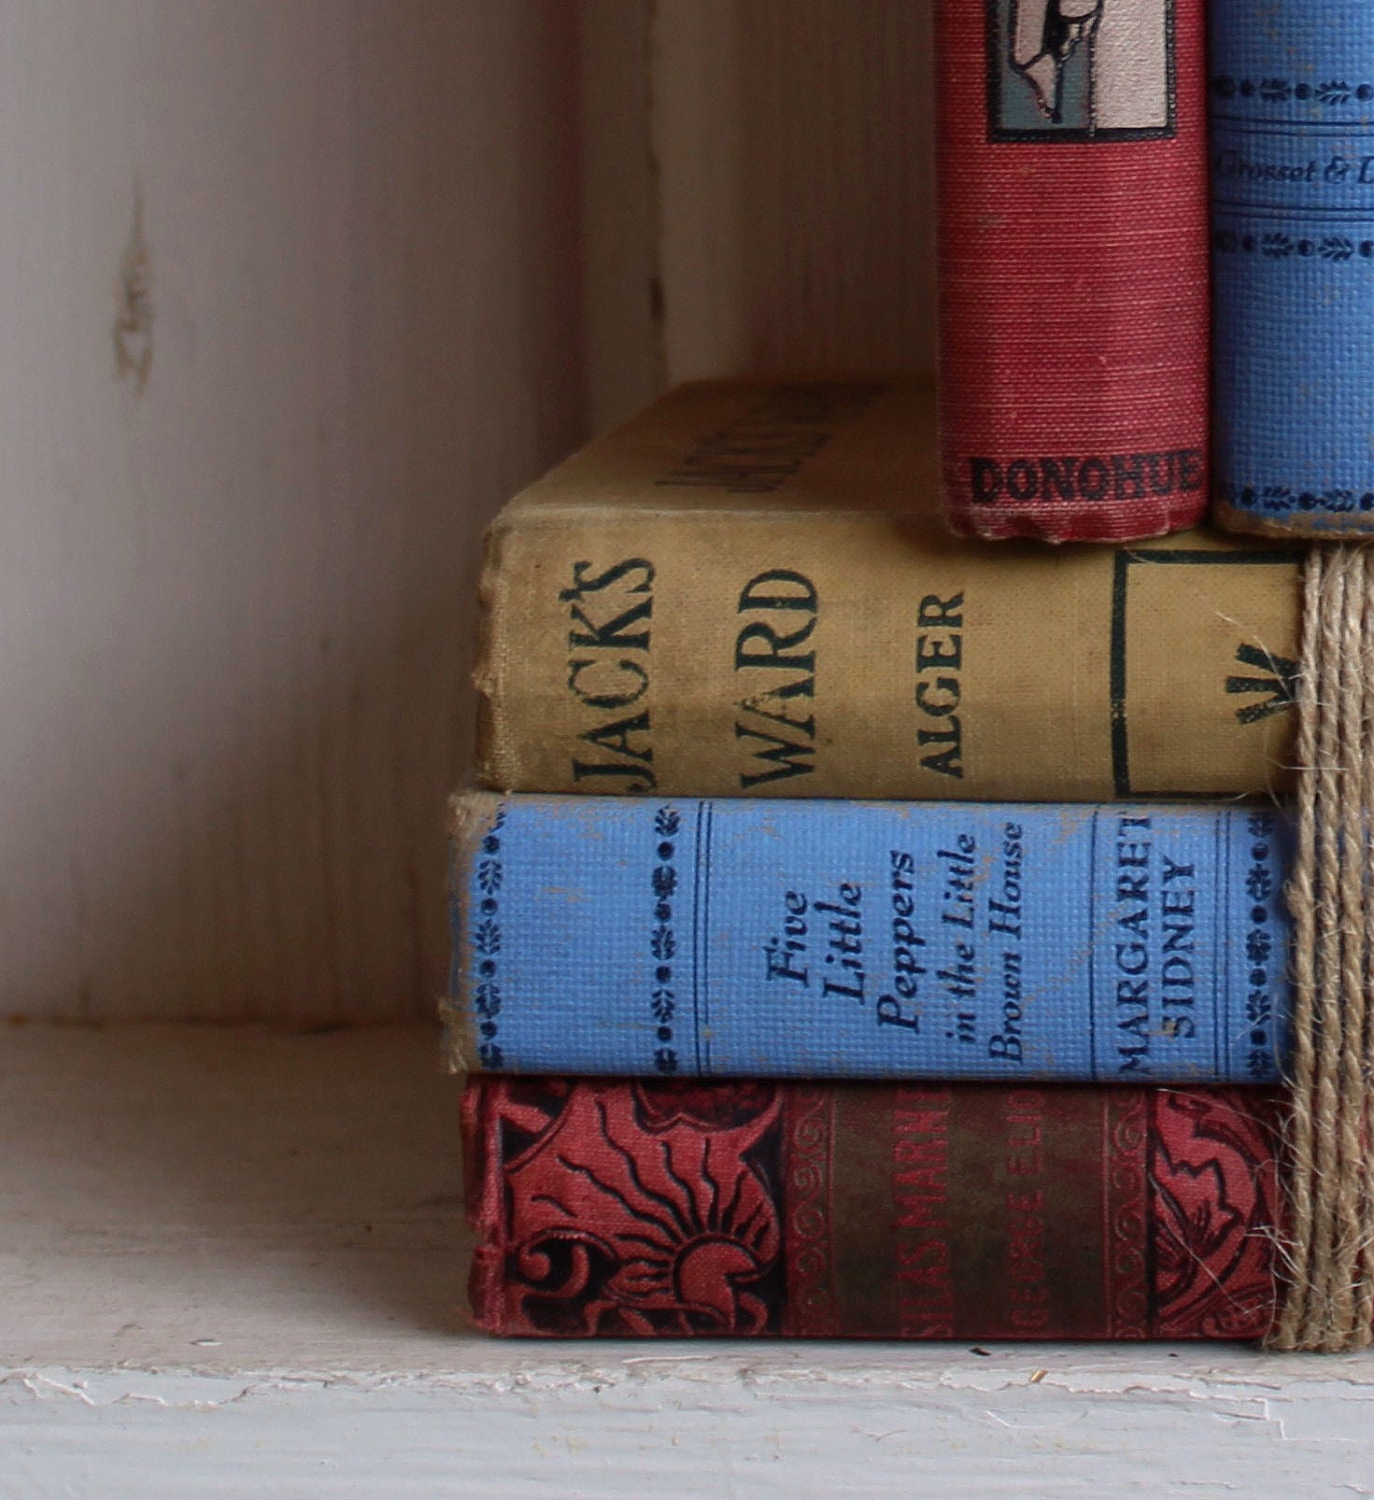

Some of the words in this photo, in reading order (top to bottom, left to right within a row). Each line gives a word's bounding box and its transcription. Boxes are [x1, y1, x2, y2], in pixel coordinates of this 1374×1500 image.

[1215, 151, 1317, 183] Grosset
[1324, 156, 1350, 185] &
[970, 450, 1203, 504] DONOHUE
[559, 557, 656, 793] JACK'S
[735, 569, 819, 790] WARD
[915, 591, 964, 780] ALGER
[765, 890, 810, 987] Five
[937, 832, 978, 931] Little
[988, 821, 1024, 941] House
[814, 882, 866, 1006] Little
[877, 850, 926, 1035] Peppers
[937, 939, 978, 1000] the
[1160, 855, 1196, 1038] SIDNEY
[945, 1013, 978, 1045] in
[988, 951, 1024, 1066] Brown
[1005, 1190, 1050, 1328] GEORGE
